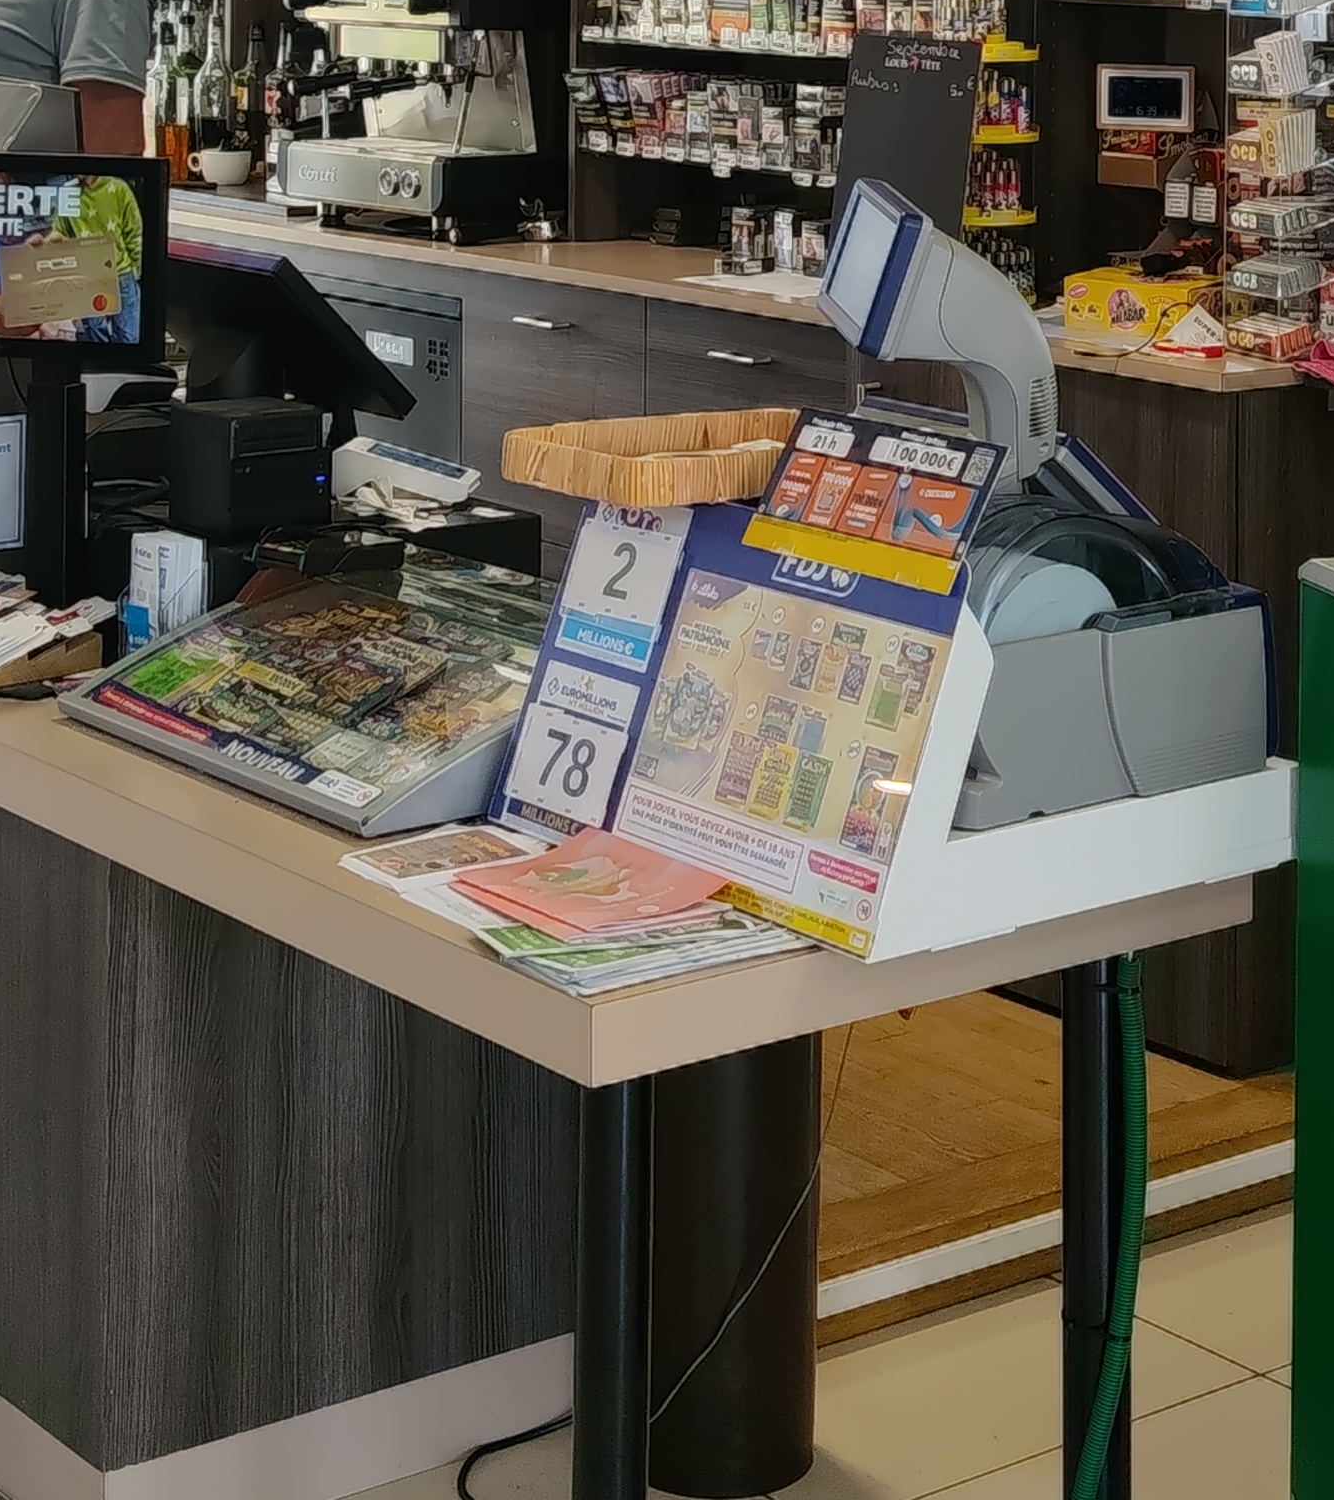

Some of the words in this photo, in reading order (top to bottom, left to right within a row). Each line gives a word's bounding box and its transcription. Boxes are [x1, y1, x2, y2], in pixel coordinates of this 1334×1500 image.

[1231, 65, 1258, 81] OCB
[1230, 144, 1257, 161] OCB
[1231, 212, 1257, 229] OCB
[1233, 271, 1258, 289] OCB
[1111, 308, 1146, 326] MALABAR
[1193, 316, 1216, 338] SUPER
[891, 443, 917, 463] 100
[615, 507, 663, 532] LOTO
[602, 542, 637, 600] 2
[781, 555, 829, 581] FDJ
[577, 628, 624, 651] MILLIONS
[624, 642, 635, 655] €
[680, 627, 732, 650] PATRIMOINE
[561, 685, 617, 711] EUROMILLIONS
[221, 739, 306, 781] NOUVEAU
[539, 728, 596, 797] 78
[801, 757, 827, 775] CASH
[521, 803, 568, 833] MILLIONS
[631, 807, 644, 818] UNE
[645, 810, 662, 824] PIÈCE
[698, 830, 714, 844] PEUT
[716, 836, 733, 850] VOUS
[632, 794, 652, 808] POUR
[679, 810, 699, 825] VOUS
[700, 817, 725, 834] DEVEZ
[725, 826, 750, 844] AVOIR
[757, 837, 767, 848] DE
[778, 844, 796, 860] ANS
